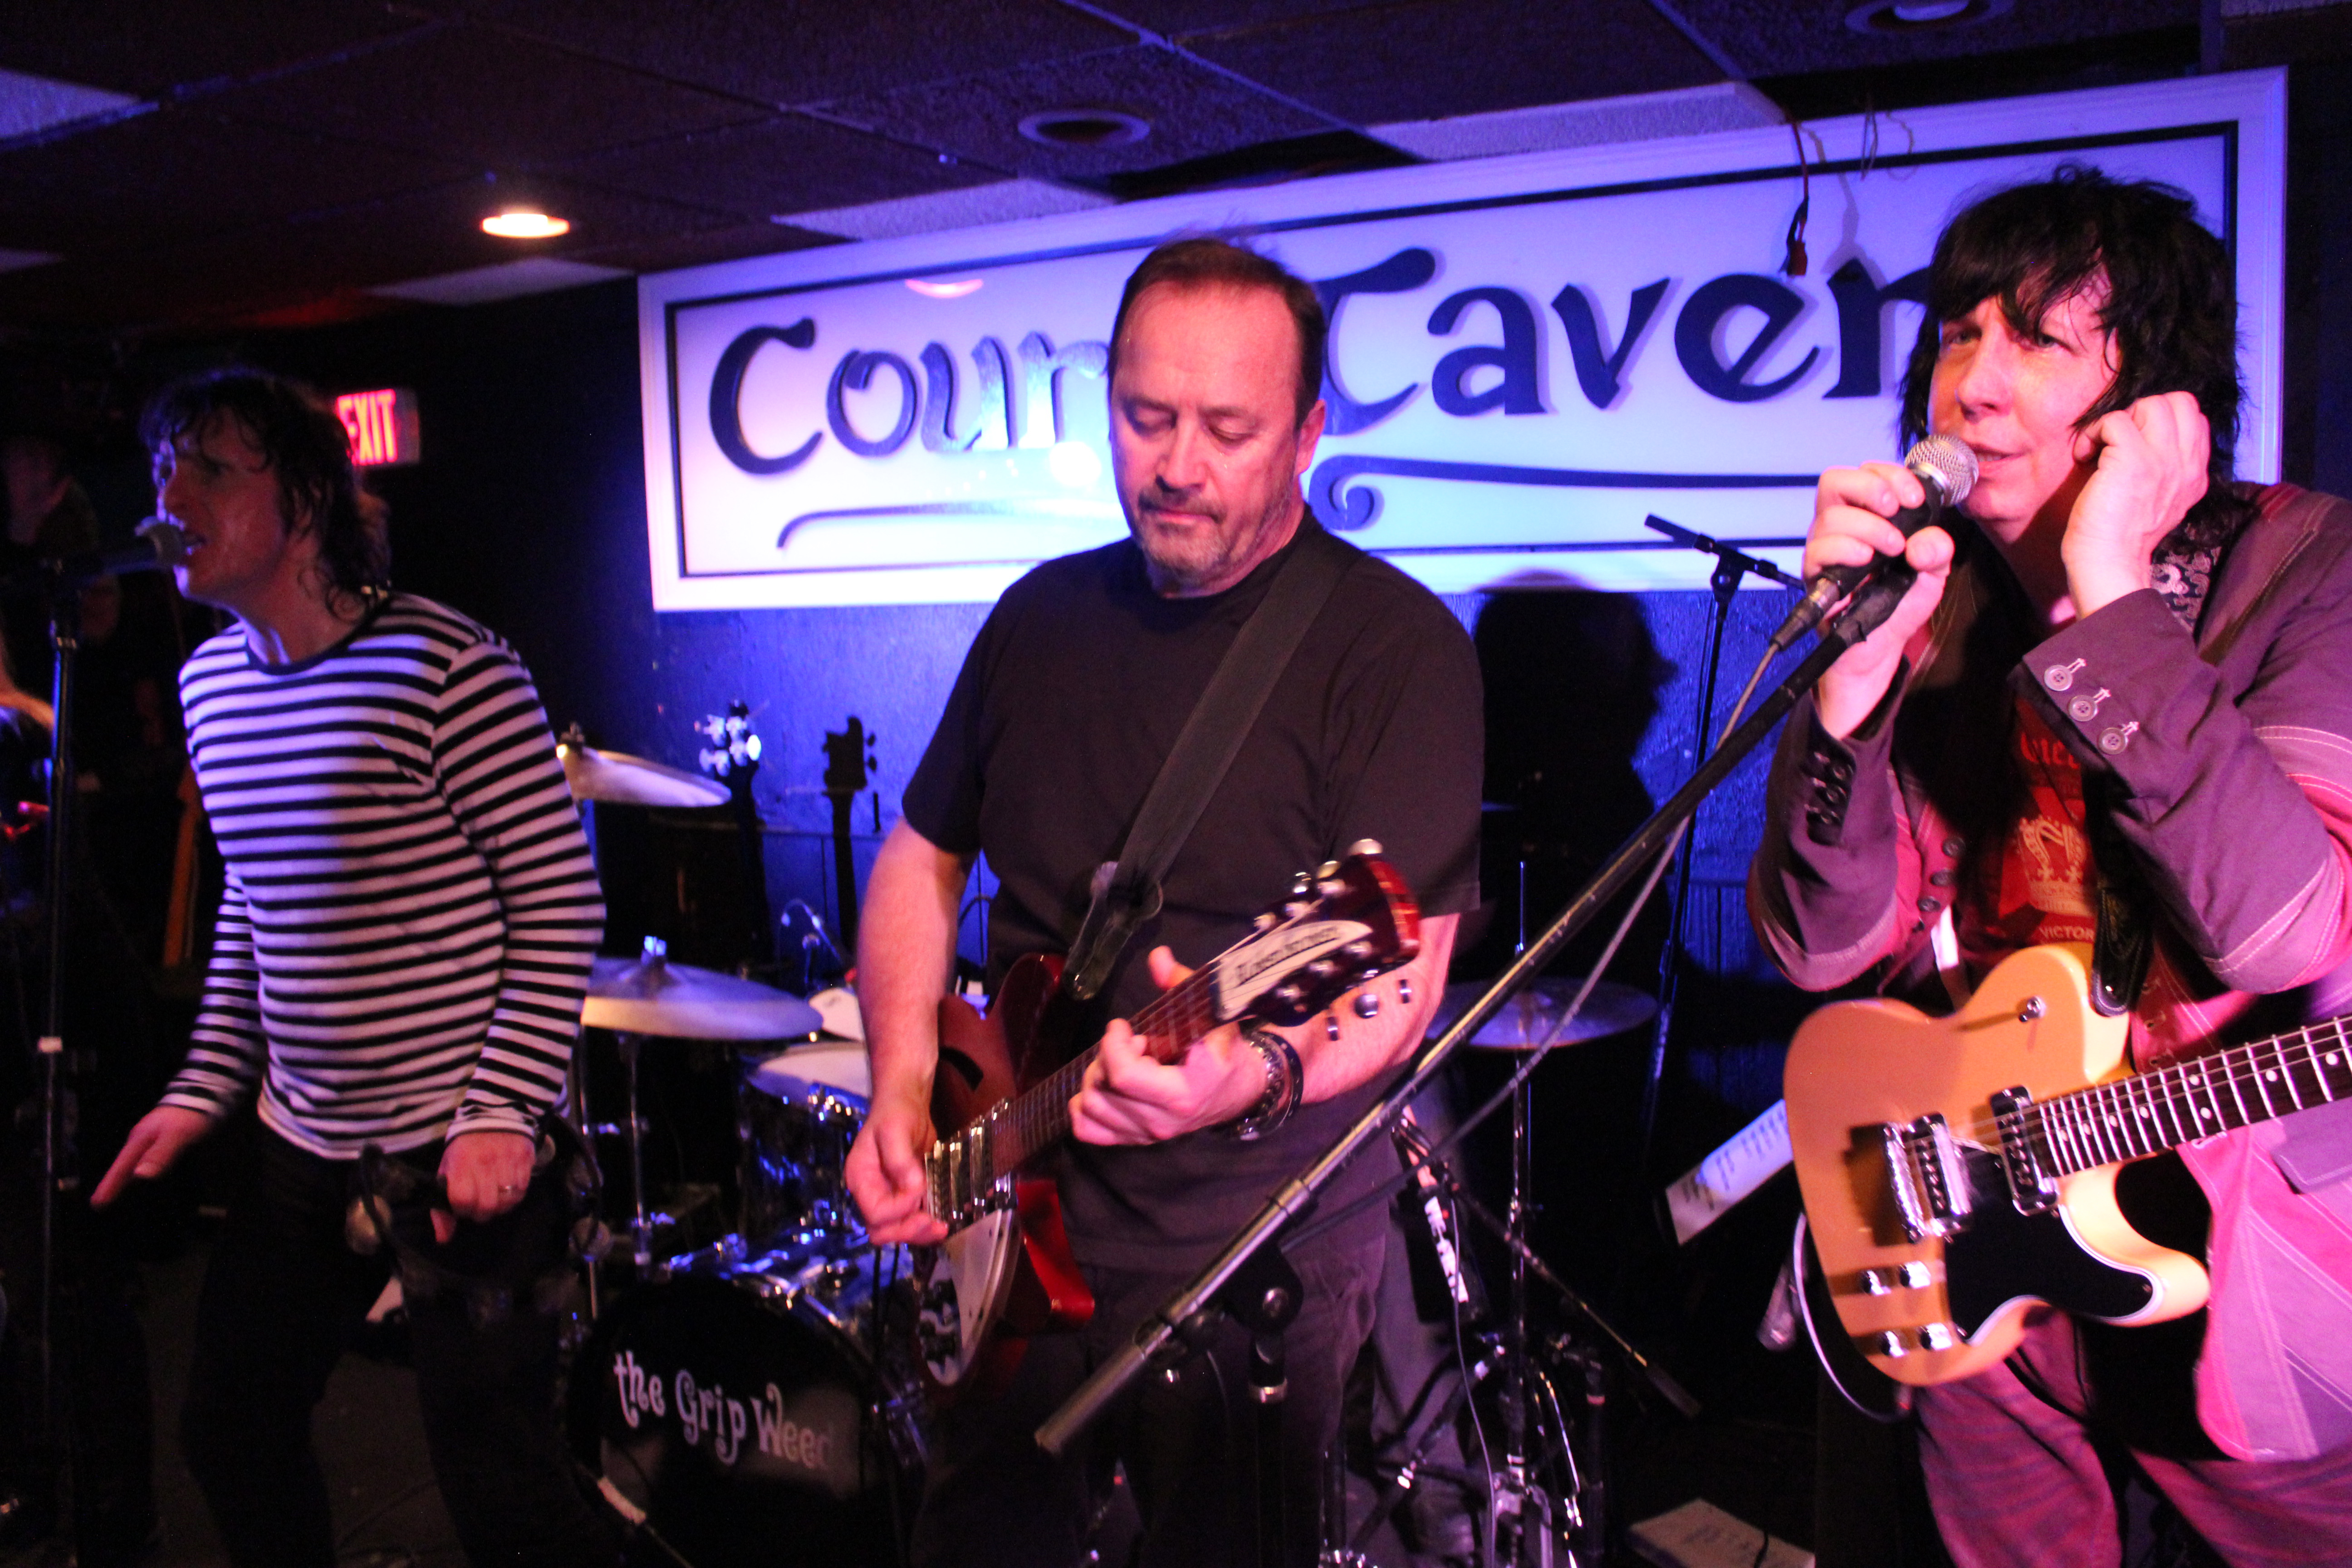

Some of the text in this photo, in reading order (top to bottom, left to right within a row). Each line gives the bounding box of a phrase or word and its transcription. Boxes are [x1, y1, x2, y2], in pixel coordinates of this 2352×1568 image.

[336, 390, 397, 465] EXIT
[614, 1351, 666, 1427] the
[675, 1370, 746, 1465] Grip
